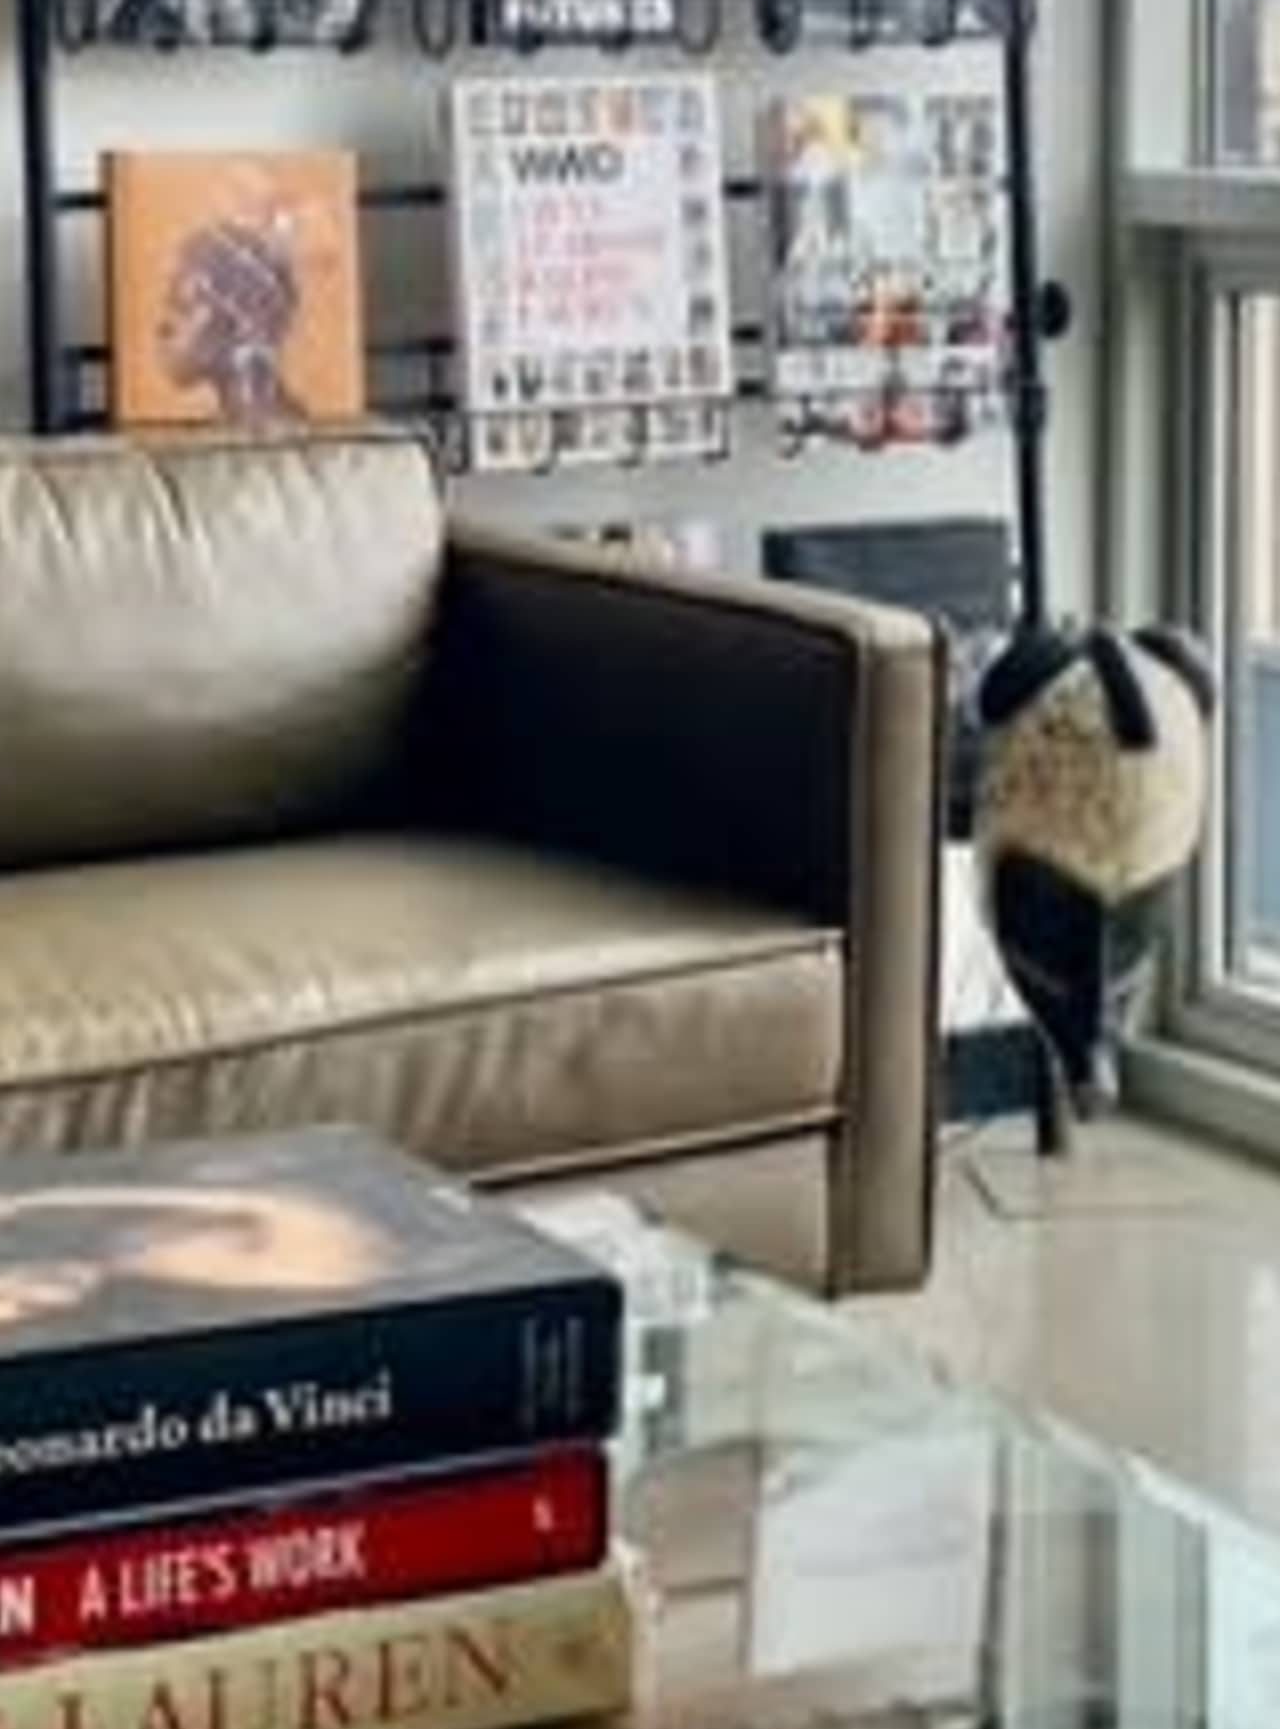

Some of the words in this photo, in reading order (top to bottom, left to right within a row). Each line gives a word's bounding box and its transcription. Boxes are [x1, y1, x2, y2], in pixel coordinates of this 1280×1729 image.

[198, 1391, 259, 1443] da
[263, 1366, 393, 1432] Vinci
[80, 1563, 107, 1622] A
[120, 1541, 238, 1617] LIFE'S
[244, 1521, 368, 1592] WORK
